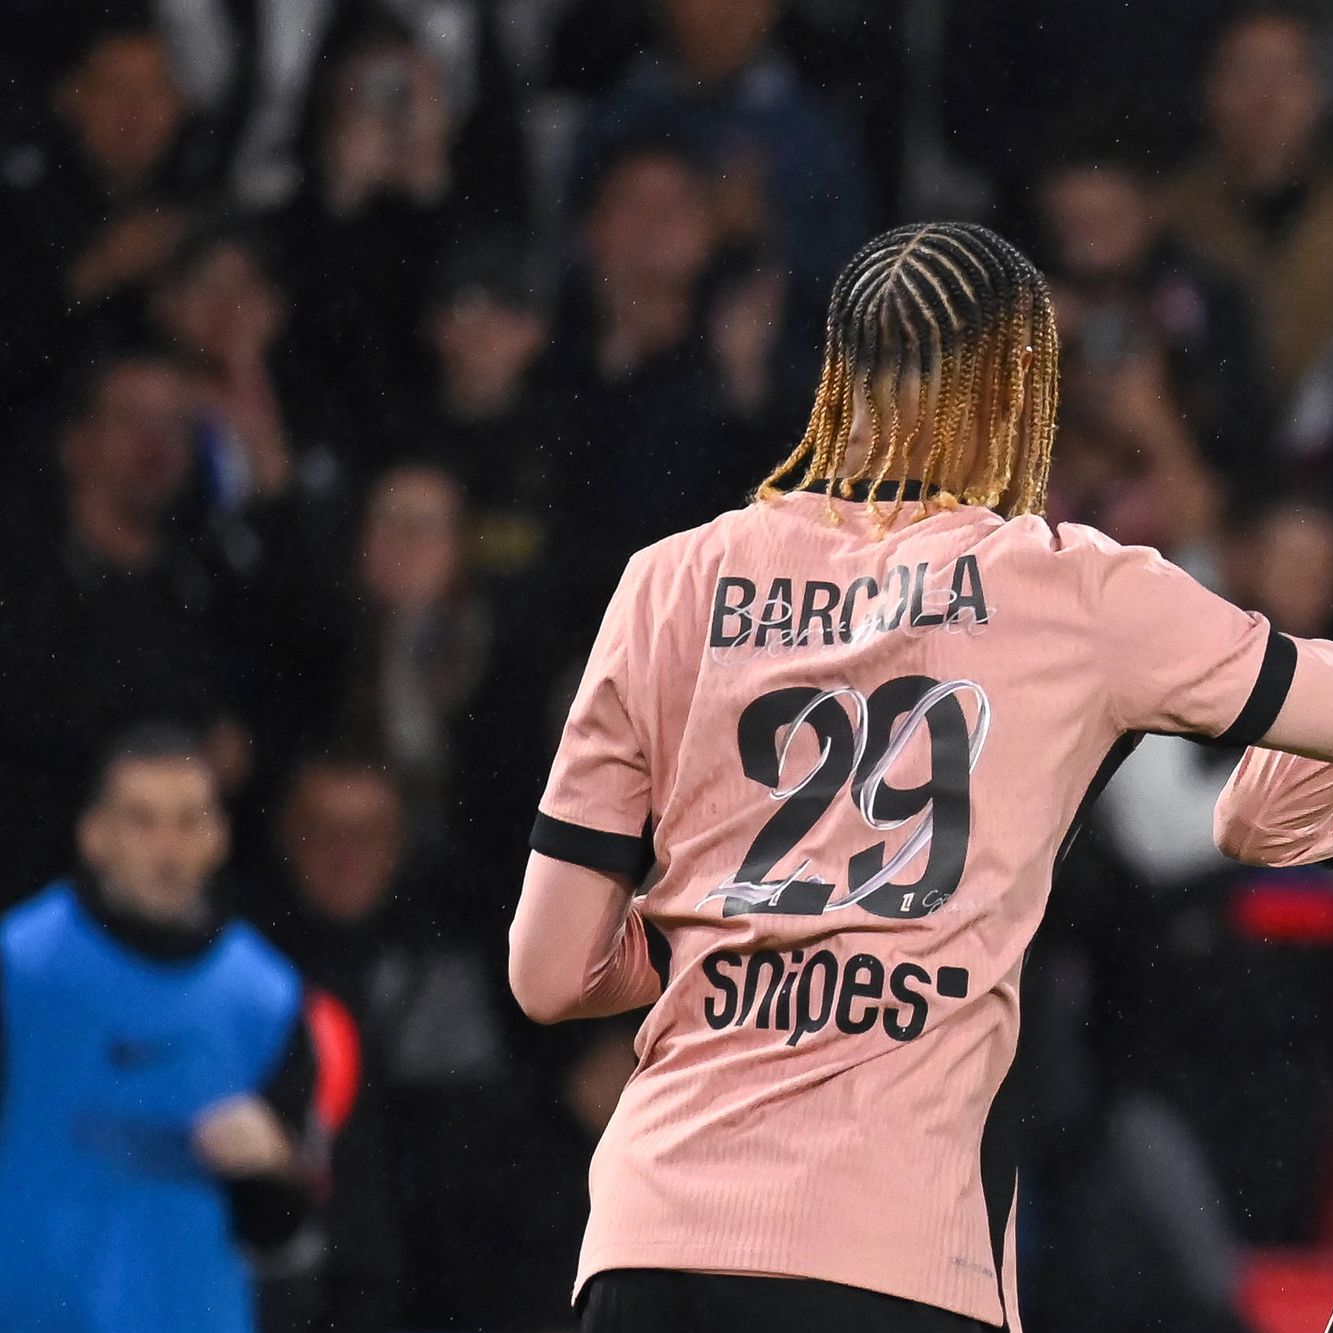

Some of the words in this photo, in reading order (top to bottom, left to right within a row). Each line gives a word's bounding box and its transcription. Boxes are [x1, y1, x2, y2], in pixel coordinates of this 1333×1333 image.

[710, 555, 988, 648] BARCOLA
[723, 675, 970, 919] 29
[701, 949, 931, 1047] snipes
